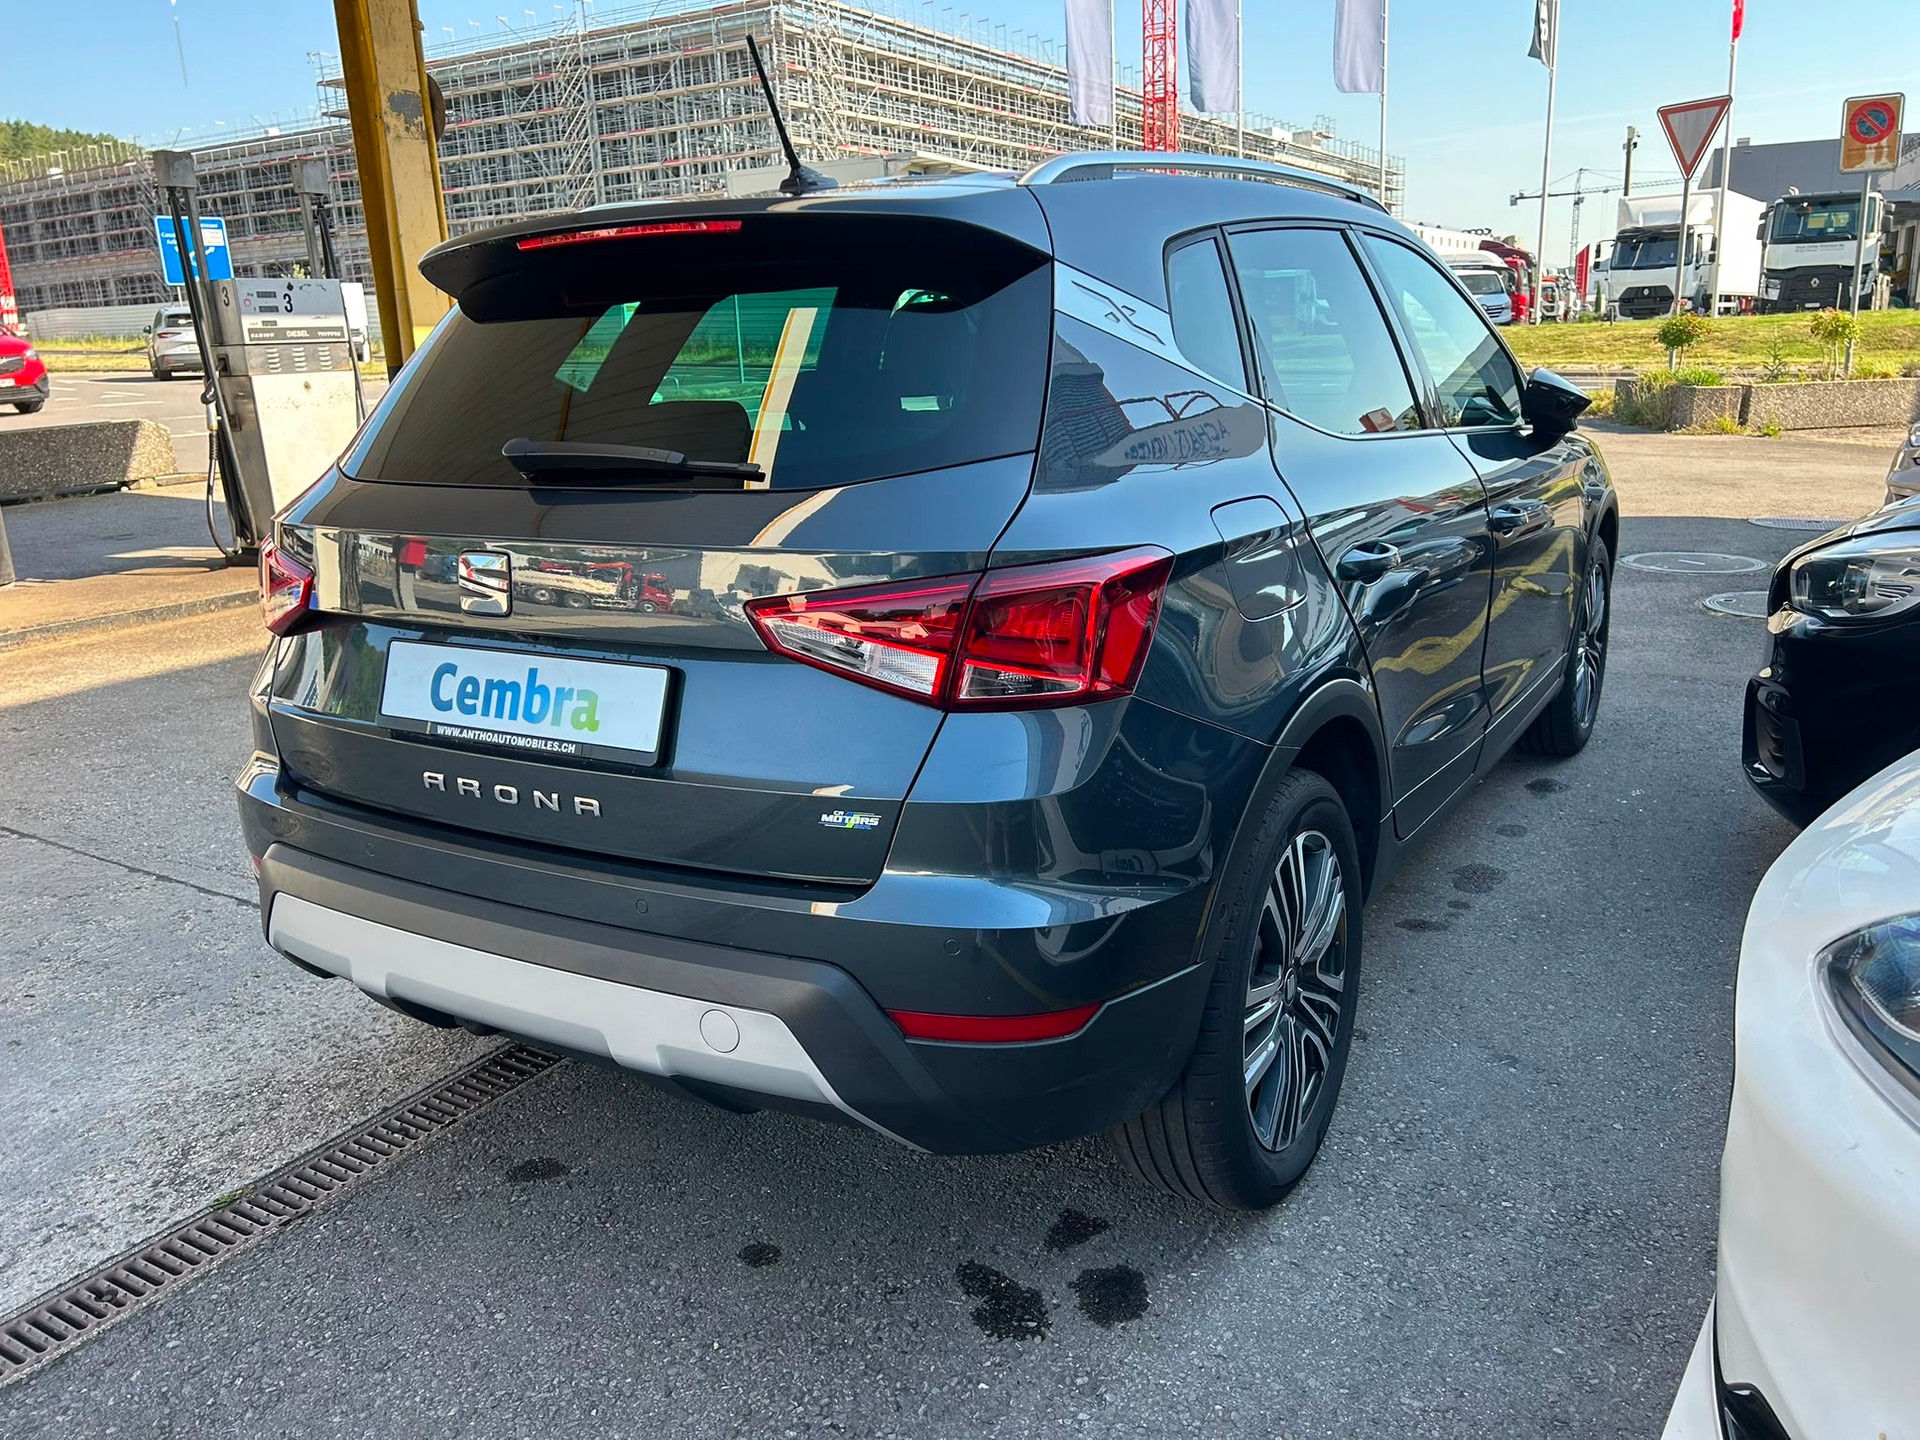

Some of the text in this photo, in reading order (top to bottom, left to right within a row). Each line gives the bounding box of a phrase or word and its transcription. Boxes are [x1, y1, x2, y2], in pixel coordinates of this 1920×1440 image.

[221, 286, 230, 307] 3
[283, 293, 293, 313] 3
[286, 330, 310, 338] DIESEL
[430, 662, 600, 732] Cembra
[437, 725, 576, 754] WWW.ANTHOAUTOMOBILES.CH
[422, 771, 602, 818] ARONA
[821, 814, 880, 826] MOTORS
